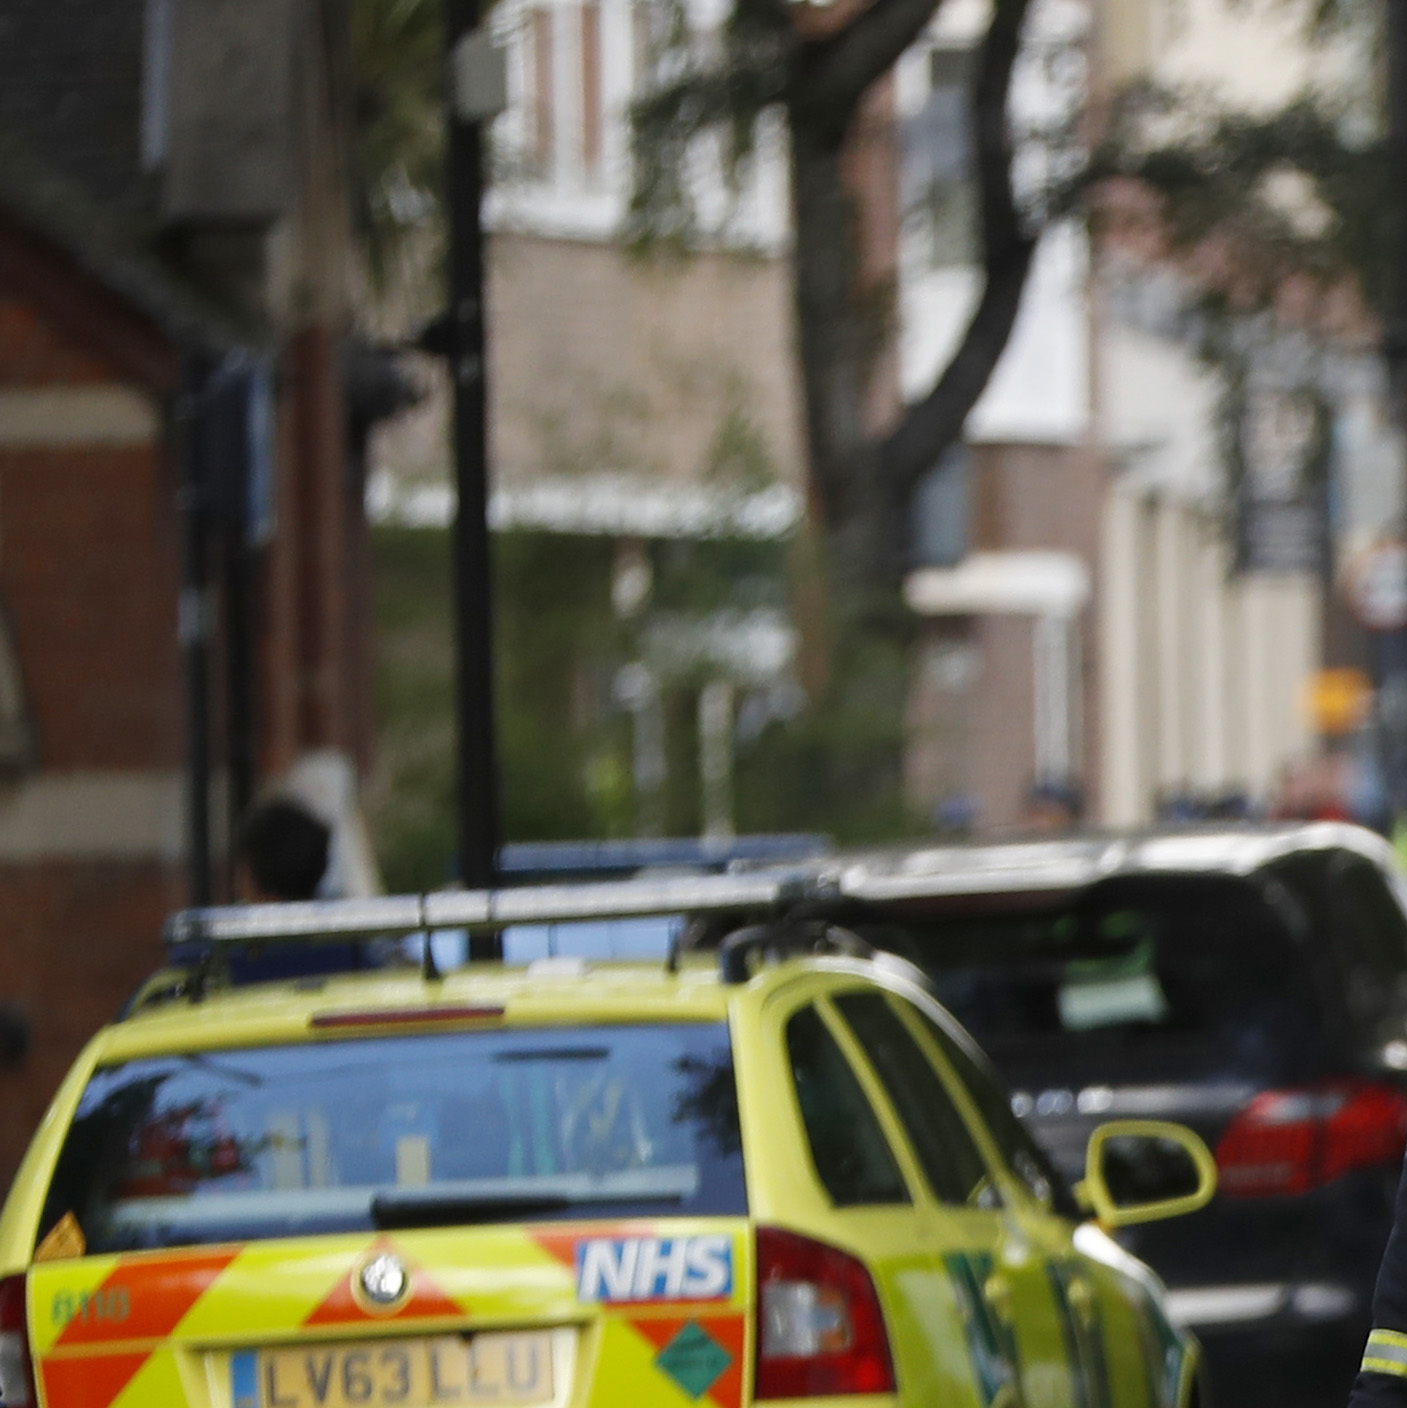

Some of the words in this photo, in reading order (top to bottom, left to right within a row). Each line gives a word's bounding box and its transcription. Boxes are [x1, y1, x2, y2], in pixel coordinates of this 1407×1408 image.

[577, 1236, 730, 1302] NHS
[266, 1348, 410, 1407] LV63
[430, 1340, 540, 1400] LLU
